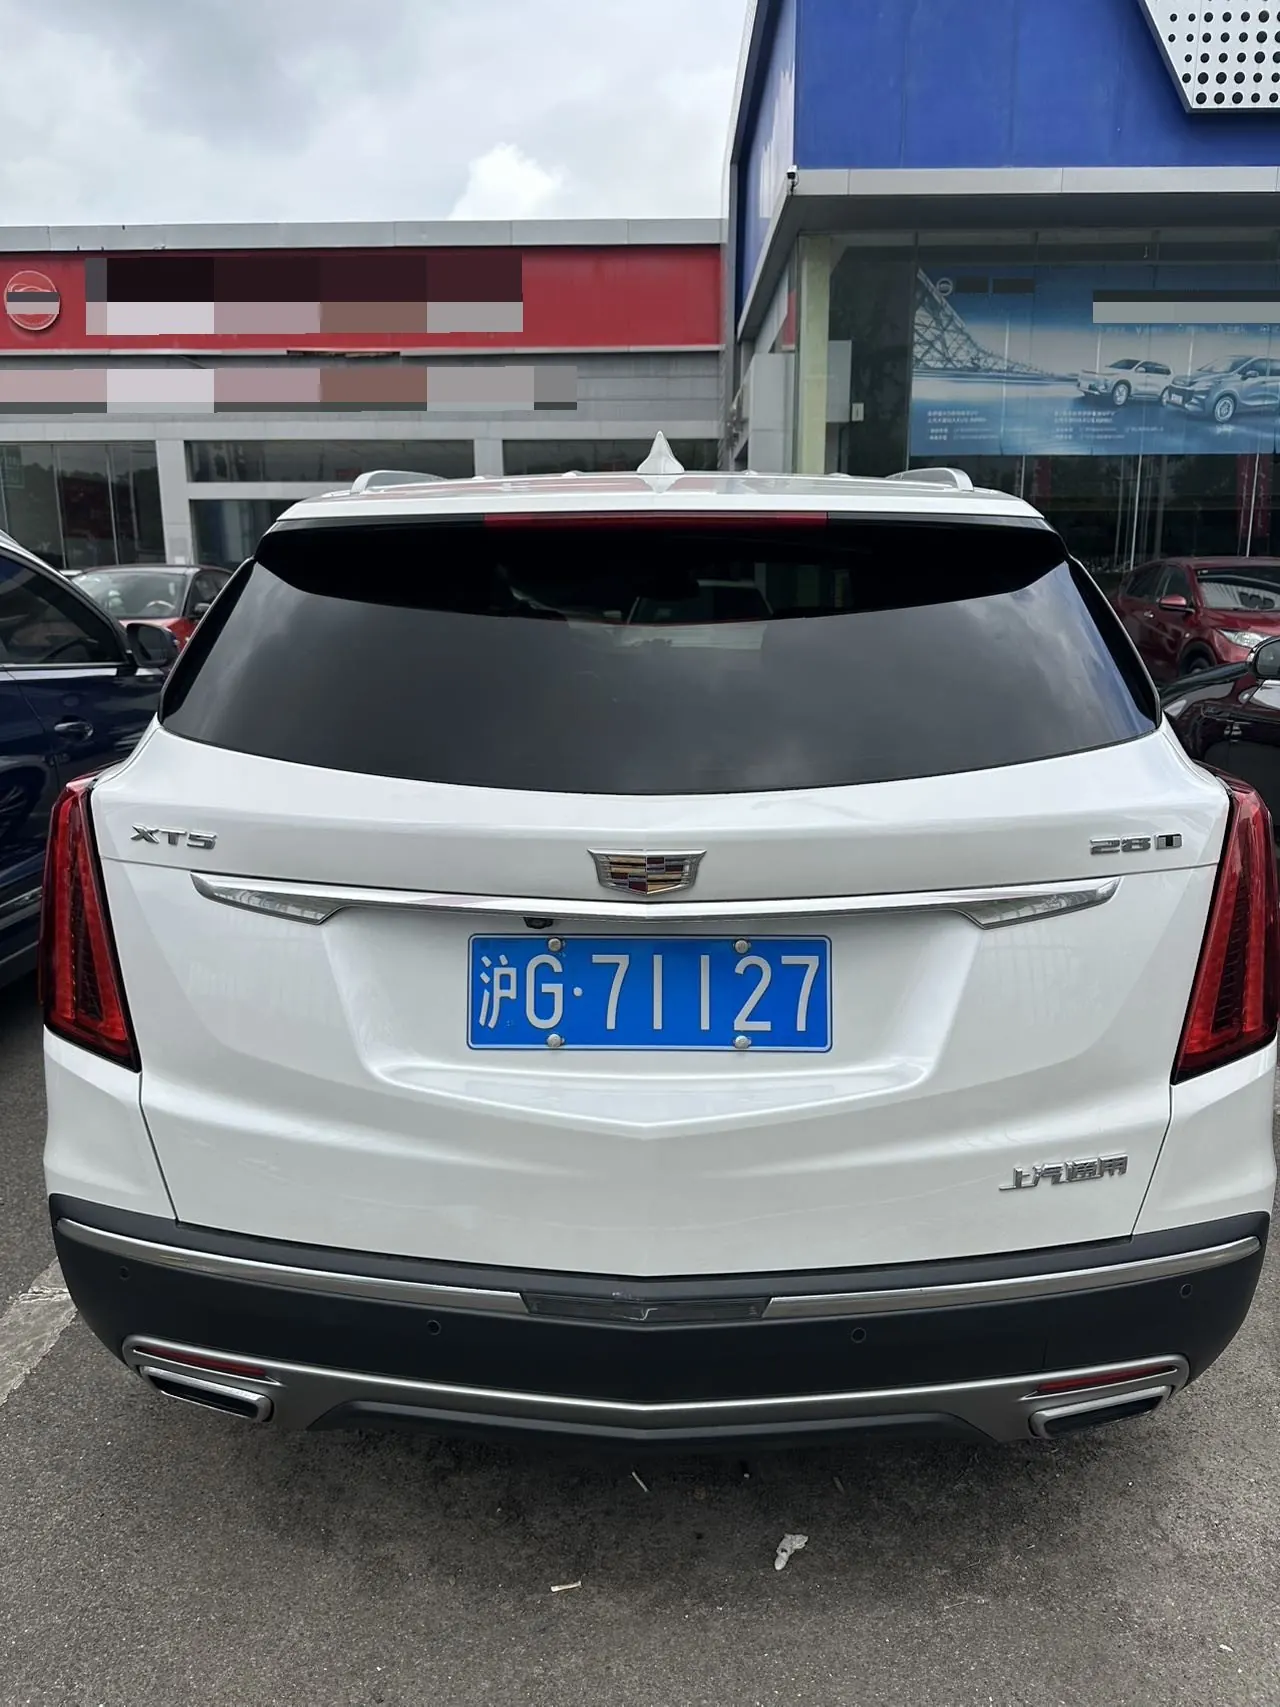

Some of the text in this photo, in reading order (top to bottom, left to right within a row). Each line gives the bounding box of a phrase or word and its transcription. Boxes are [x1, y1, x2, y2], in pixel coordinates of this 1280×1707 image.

[131, 823, 217, 849] XT5
[999, 1153, 1129, 1188] 上汽通用
